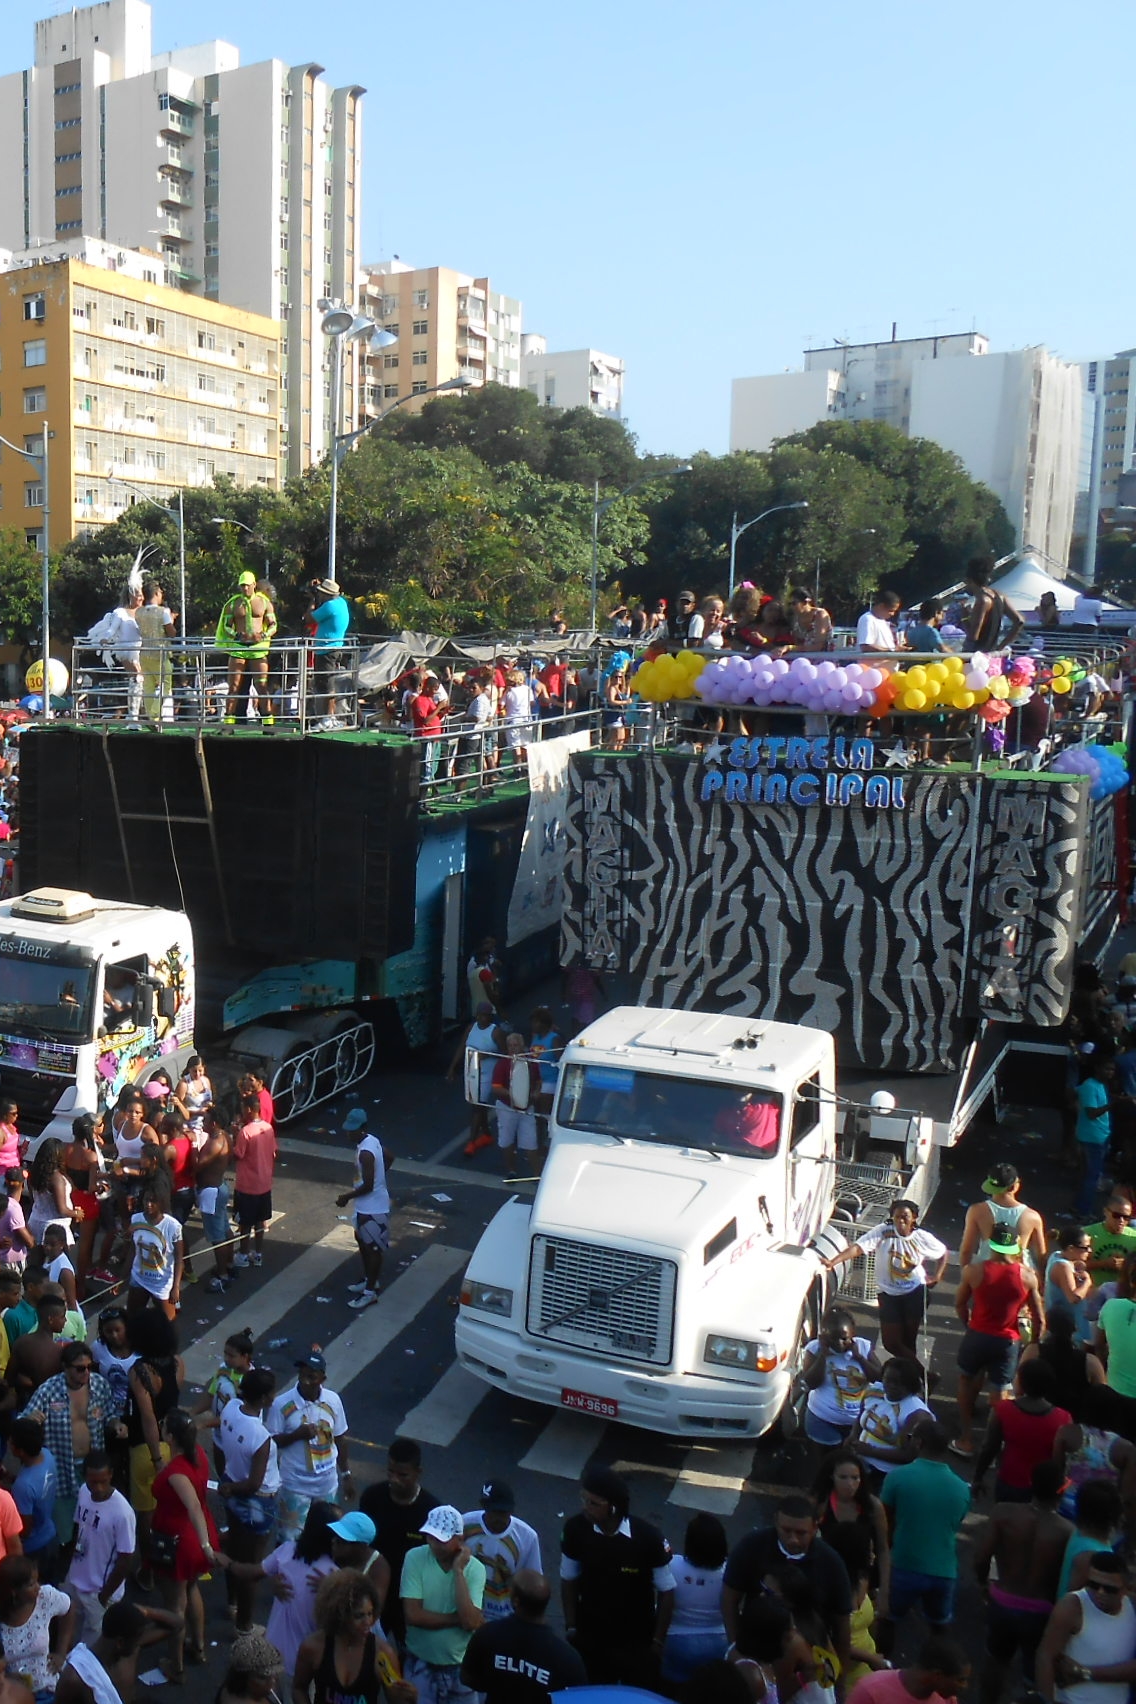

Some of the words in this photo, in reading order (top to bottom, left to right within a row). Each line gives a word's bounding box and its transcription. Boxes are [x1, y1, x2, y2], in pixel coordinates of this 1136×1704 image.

[727, 736, 874, 770] ESTRELA
[700, 771, 906, 809] PRINCIPAL
[494, 1654, 551, 1685] ELITE
